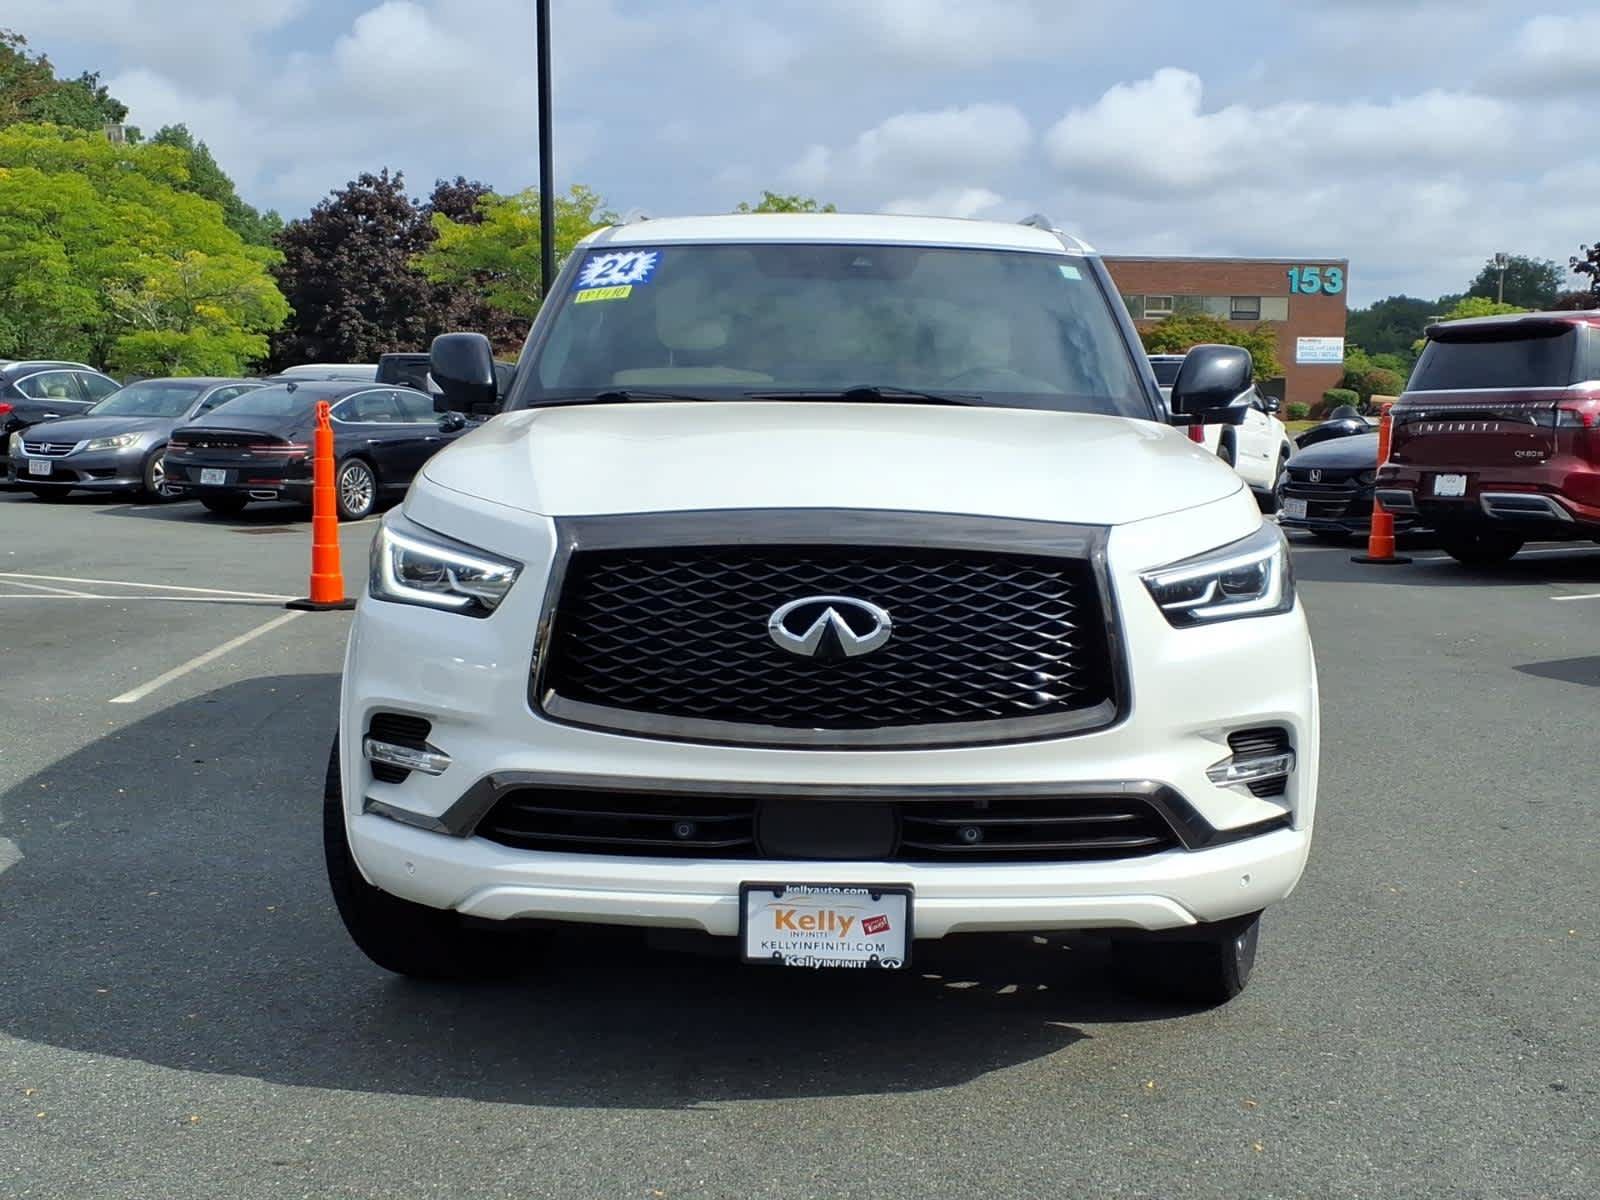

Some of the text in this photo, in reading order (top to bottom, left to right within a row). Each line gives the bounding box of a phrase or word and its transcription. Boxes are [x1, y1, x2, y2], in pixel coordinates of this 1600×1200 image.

[594, 258, 639, 280] 24
[1288, 266, 1344, 294] 153
[1418, 423, 1500, 432] INFINITI
[785, 884, 869, 895] kellyauto.com
[775, 909, 855, 937] Kelly
[760, 940, 886, 952] KELLYINFINITI.COM
